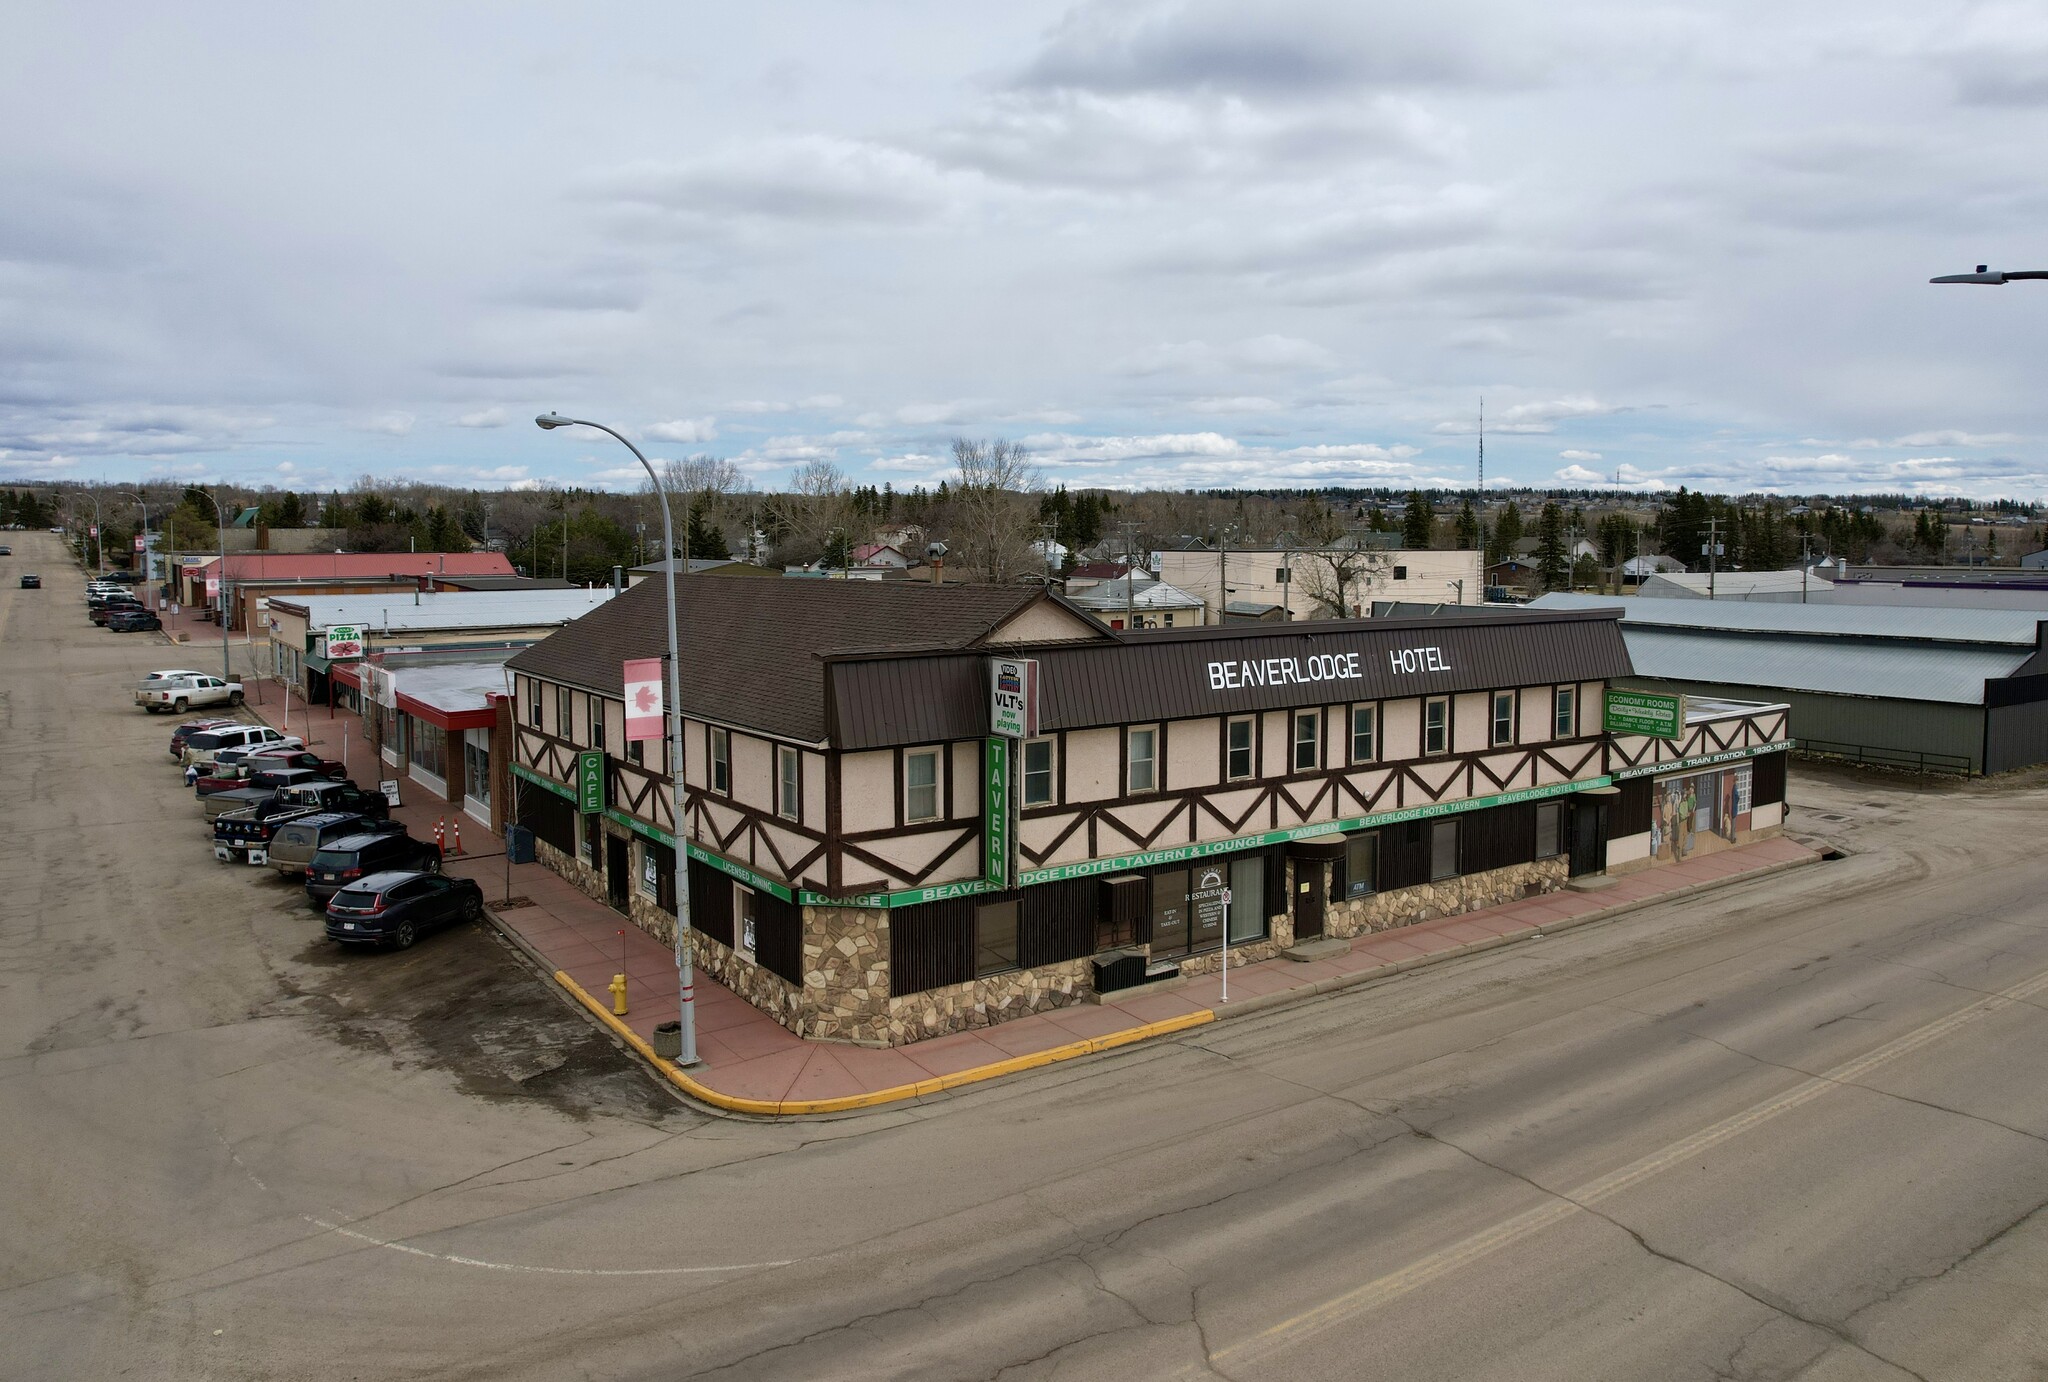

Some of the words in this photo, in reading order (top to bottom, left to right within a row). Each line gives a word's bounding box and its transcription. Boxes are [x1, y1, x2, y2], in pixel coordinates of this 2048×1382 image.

[330, 633, 360, 641] PIZZA
[1001, 665, 1017, 674] VIDEO
[1208, 653, 1362, 690] BEAVERLODGE
[1390, 647, 1451, 675] HOTEL
[995, 692, 1023, 711] VLT's
[1609, 695, 1645, 706] ECONOMY
[1647, 700, 1675, 709] ROOMS
[1002, 710, 1016, 719] now
[1611, 705, 1629, 714] Daily
[1632, 708, 1654, 717] Weekly
[997, 718, 1021, 733] playing
[1619, 761, 1682, 779] BEAVERLODGE
[1686, 757, 1711, 767] TRAIN
[1713, 750, 1746, 762] STATION
[1752, 741, 1791, 754] 1930-1971
[585, 757, 598, 808] CAFE
[1497, 788, 1549, 804] BEAVERLODGE
[1551, 785, 1573, 795] HOTEL
[1574, 779, 1600, 790] TAVERN
[991, 745, 1002, 878] TAVERN
[1360, 809, 1420, 826] BEAVERLODGE
[1422, 805, 1449, 816] HOTEL
[1450, 800, 1480, 811] TAVERN
[1287, 823, 1340, 839] TAVERN
[693, 848, 709, 862] PIZZA
[1065, 860, 1120, 877] HOTEL
[1124, 849, 1186, 866] TAVERN
[1190, 846, 1200, 857] &
[1205, 835, 1265, 854] LOUNGE
[722, 861, 749, 880] LICENSED
[752, 874, 772, 891] DINING
[1352, 882, 1365, 891] ATM
[806, 893, 882, 906] LOUNGE
